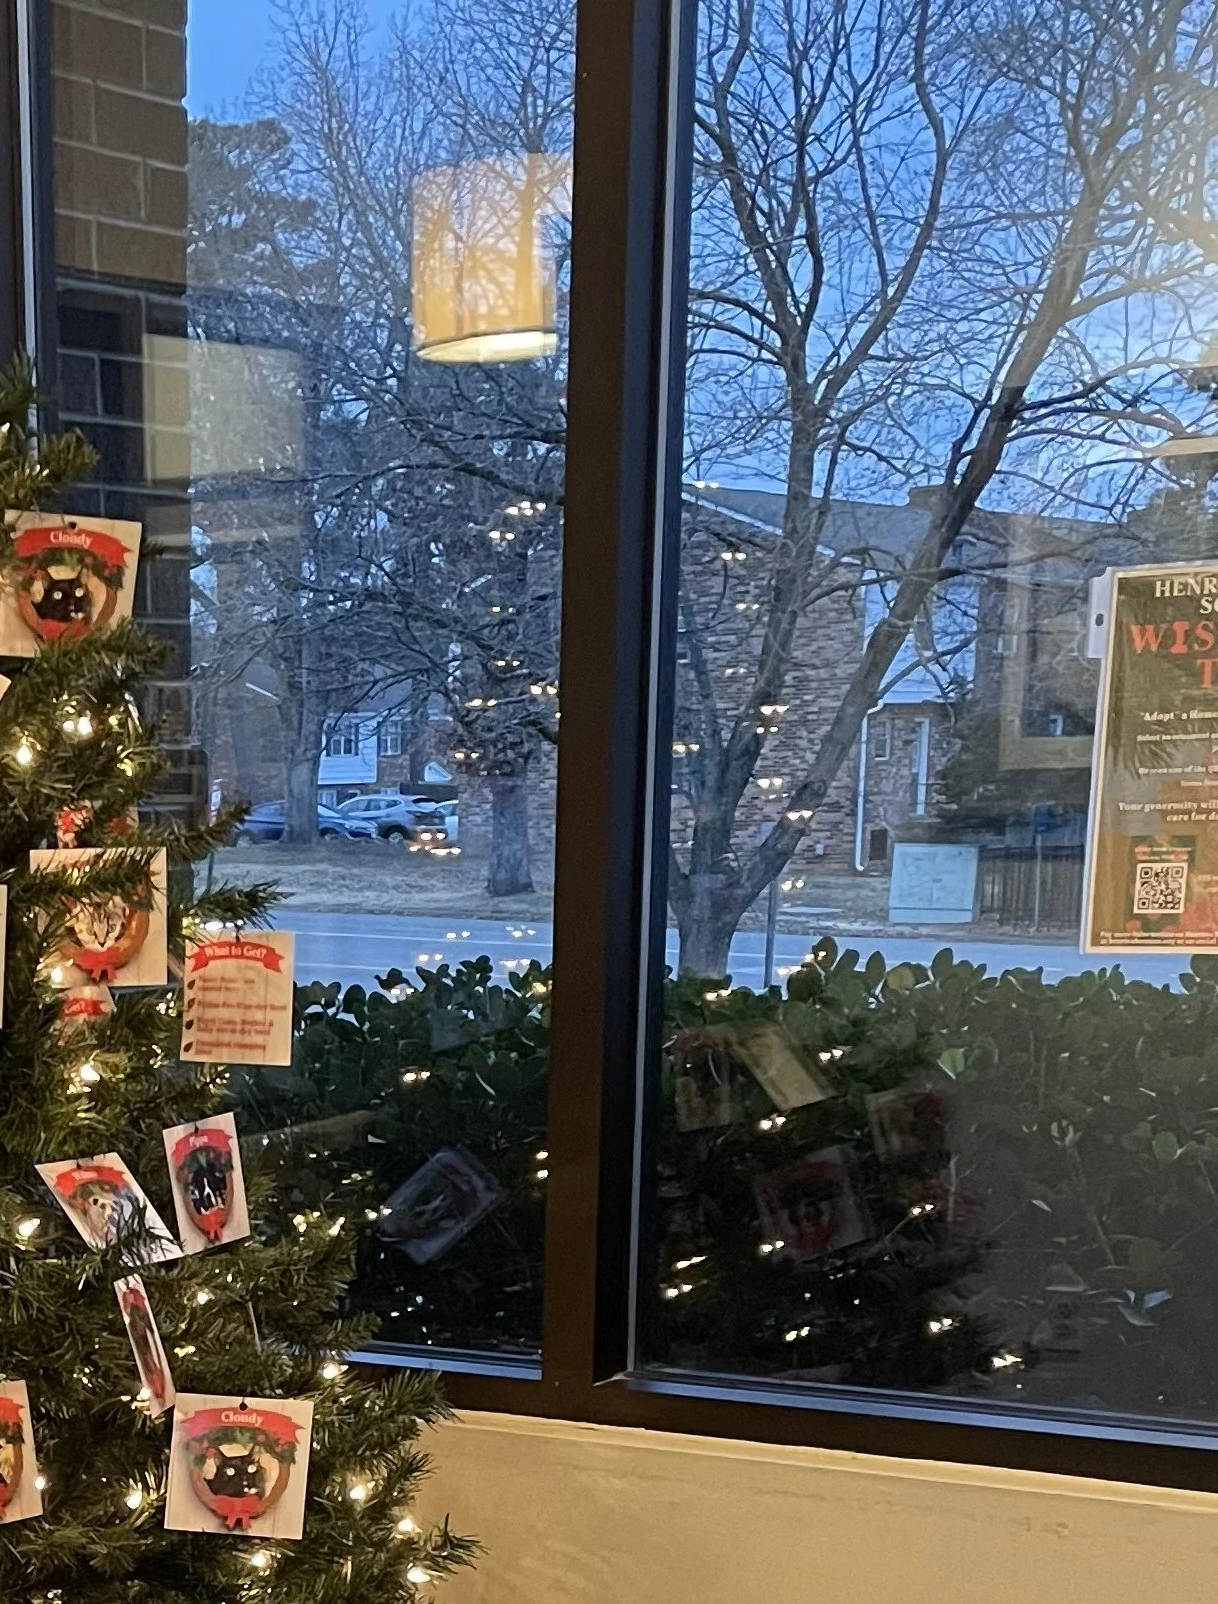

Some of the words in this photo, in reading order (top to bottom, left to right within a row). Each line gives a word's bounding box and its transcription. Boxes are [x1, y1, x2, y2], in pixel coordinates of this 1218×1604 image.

[50, 530, 92, 549] Cloudy
[1200, 596, 1218, 614] S
[204, 946, 230, 957] What
[232, 946, 242, 955] to
[243, 947, 266, 958] Get?
[221, 1411, 264, 1427] Cloudy
